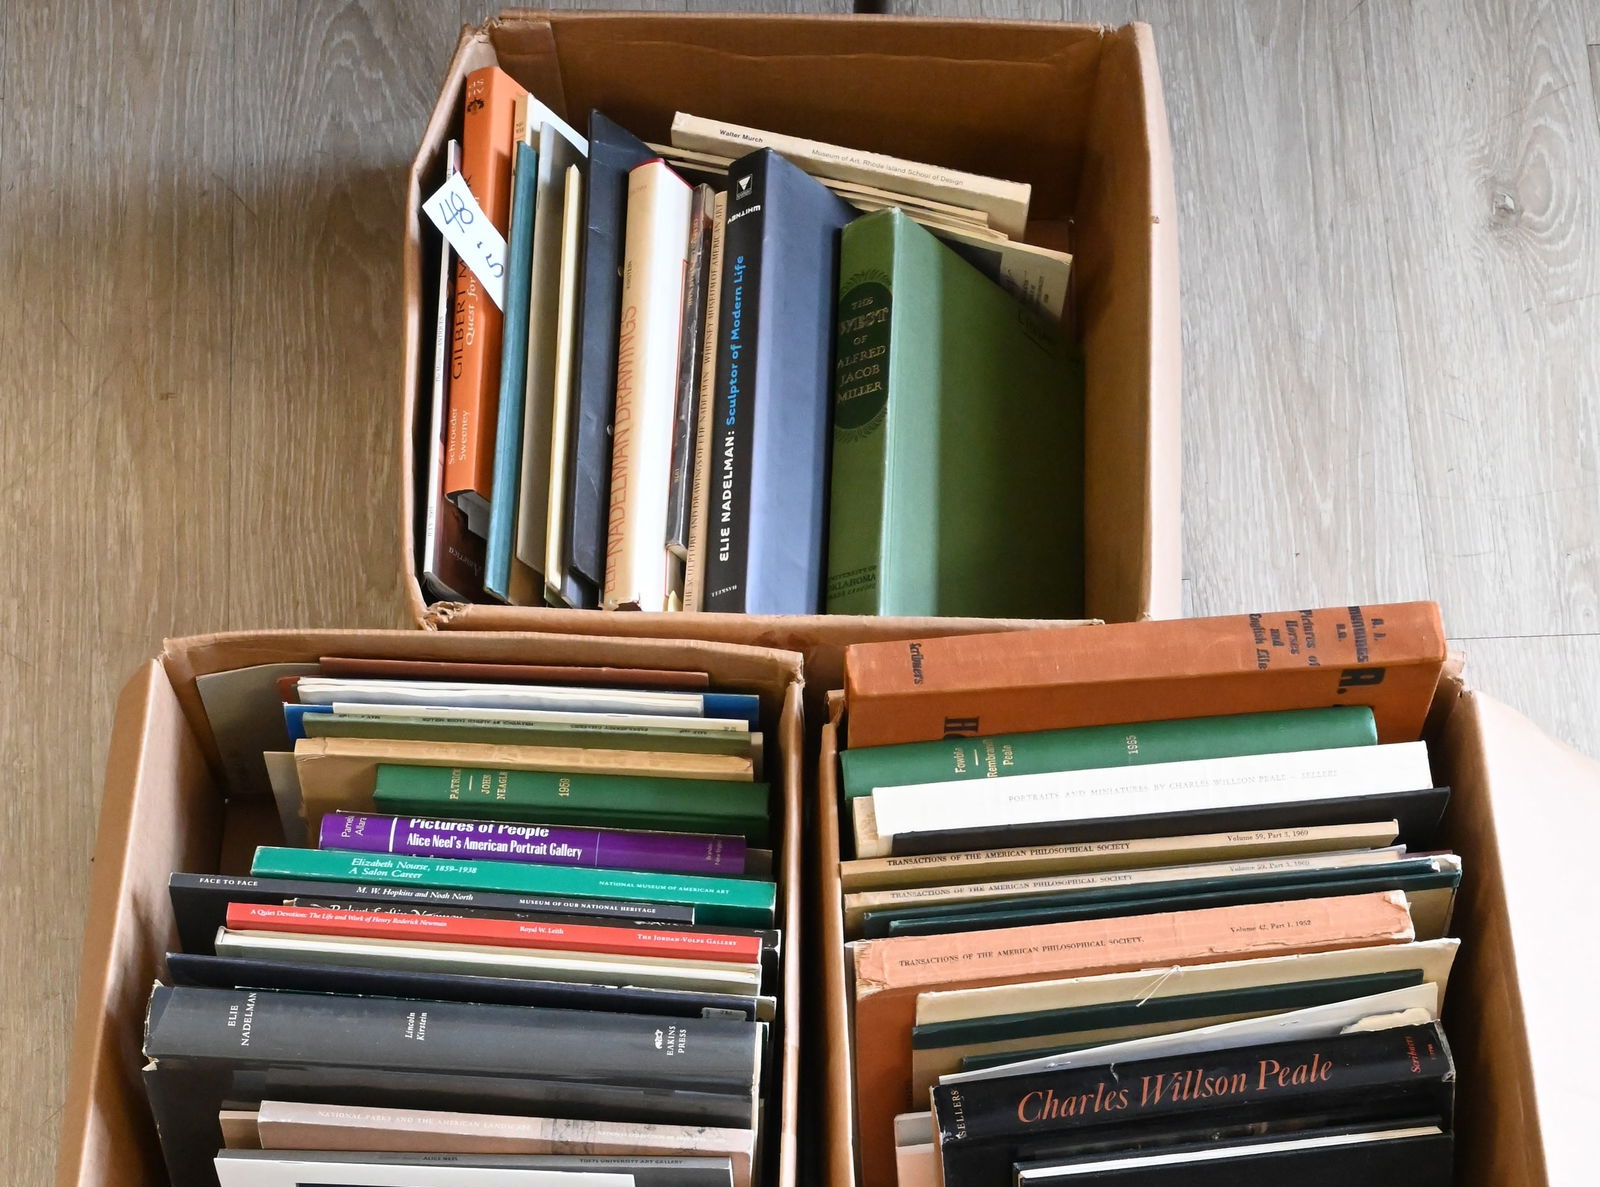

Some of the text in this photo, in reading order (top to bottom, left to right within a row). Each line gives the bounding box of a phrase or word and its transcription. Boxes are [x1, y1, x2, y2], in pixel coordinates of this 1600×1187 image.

[719, 129, 763, 143] Walter Murch
[439, 191, 474, 234] 48
[727, 205, 761, 224] WHITNEY
[484, 254, 503, 278] 5
[464, 277, 478, 345] Quest for
[851, 296, 874, 309] THE
[452, 290, 466, 380] GILBERT
[839, 308, 889, 336] WEST
[853, 336, 867, 345] OF
[615, 305, 638, 421] DRAWINGS
[837, 344, 887, 368] ALFRED
[840, 363, 880, 385] JACOB
[836, 381, 882, 404] MILLER
[720, 255, 746, 562] ELIE NADELMAN: Sculptor of Modern Life
[447, 408, 459, 464] Schroeder
[458, 410, 471, 461] Sweeney
[604, 428, 630, 556] NADELMAN
[1249, 613, 1268, 670] English Life
[1271, 628, 1284, 647] and
[1285, 620, 1300, 655] Horses
[1336, 668, 1385, 694] A.
[481, 774, 492, 794] JOHN
[410, 818, 551, 839] Pictures of People
[407, 835, 582, 860] Alice Neel's American Portrait Gallery
[887, 855, 948, 866] TRANSACTIONS
[985, 849, 1026, 859] AMERICAN
[1030, 845, 1094, 857] PHILOSOPHICAL
[1097, 842, 1131, 850] SOCIETY
[199, 877, 219, 885] FACE
[363, 868, 388, 877] Salon
[392, 869, 423, 879] Career
[370, 887, 381, 895] W.
[383, 887, 412, 898] Hopkins
[430, 891, 450, 900] Noah
[452, 893, 473, 901] North
[899, 956, 959, 968] TRANSACTIONS
[997, 947, 1039, 957] AMERICAN
[1042, 941, 1105, 952] PHILOSOPHICAL
[1109, 937, 1144, 946] SOCIETY.
[228, 1004, 238, 1027] ELIE
[241, 993, 256, 1046] NADELMAN
[405, 1012, 415, 1039] Lincoln
[417, 1012, 427, 1041] Kirstein
[667, 1025, 675, 1056] EAKINS
[1017, 1054, 1333, 1124] Charles Willson Peale
[951, 1089, 968, 1140] SELLERS
